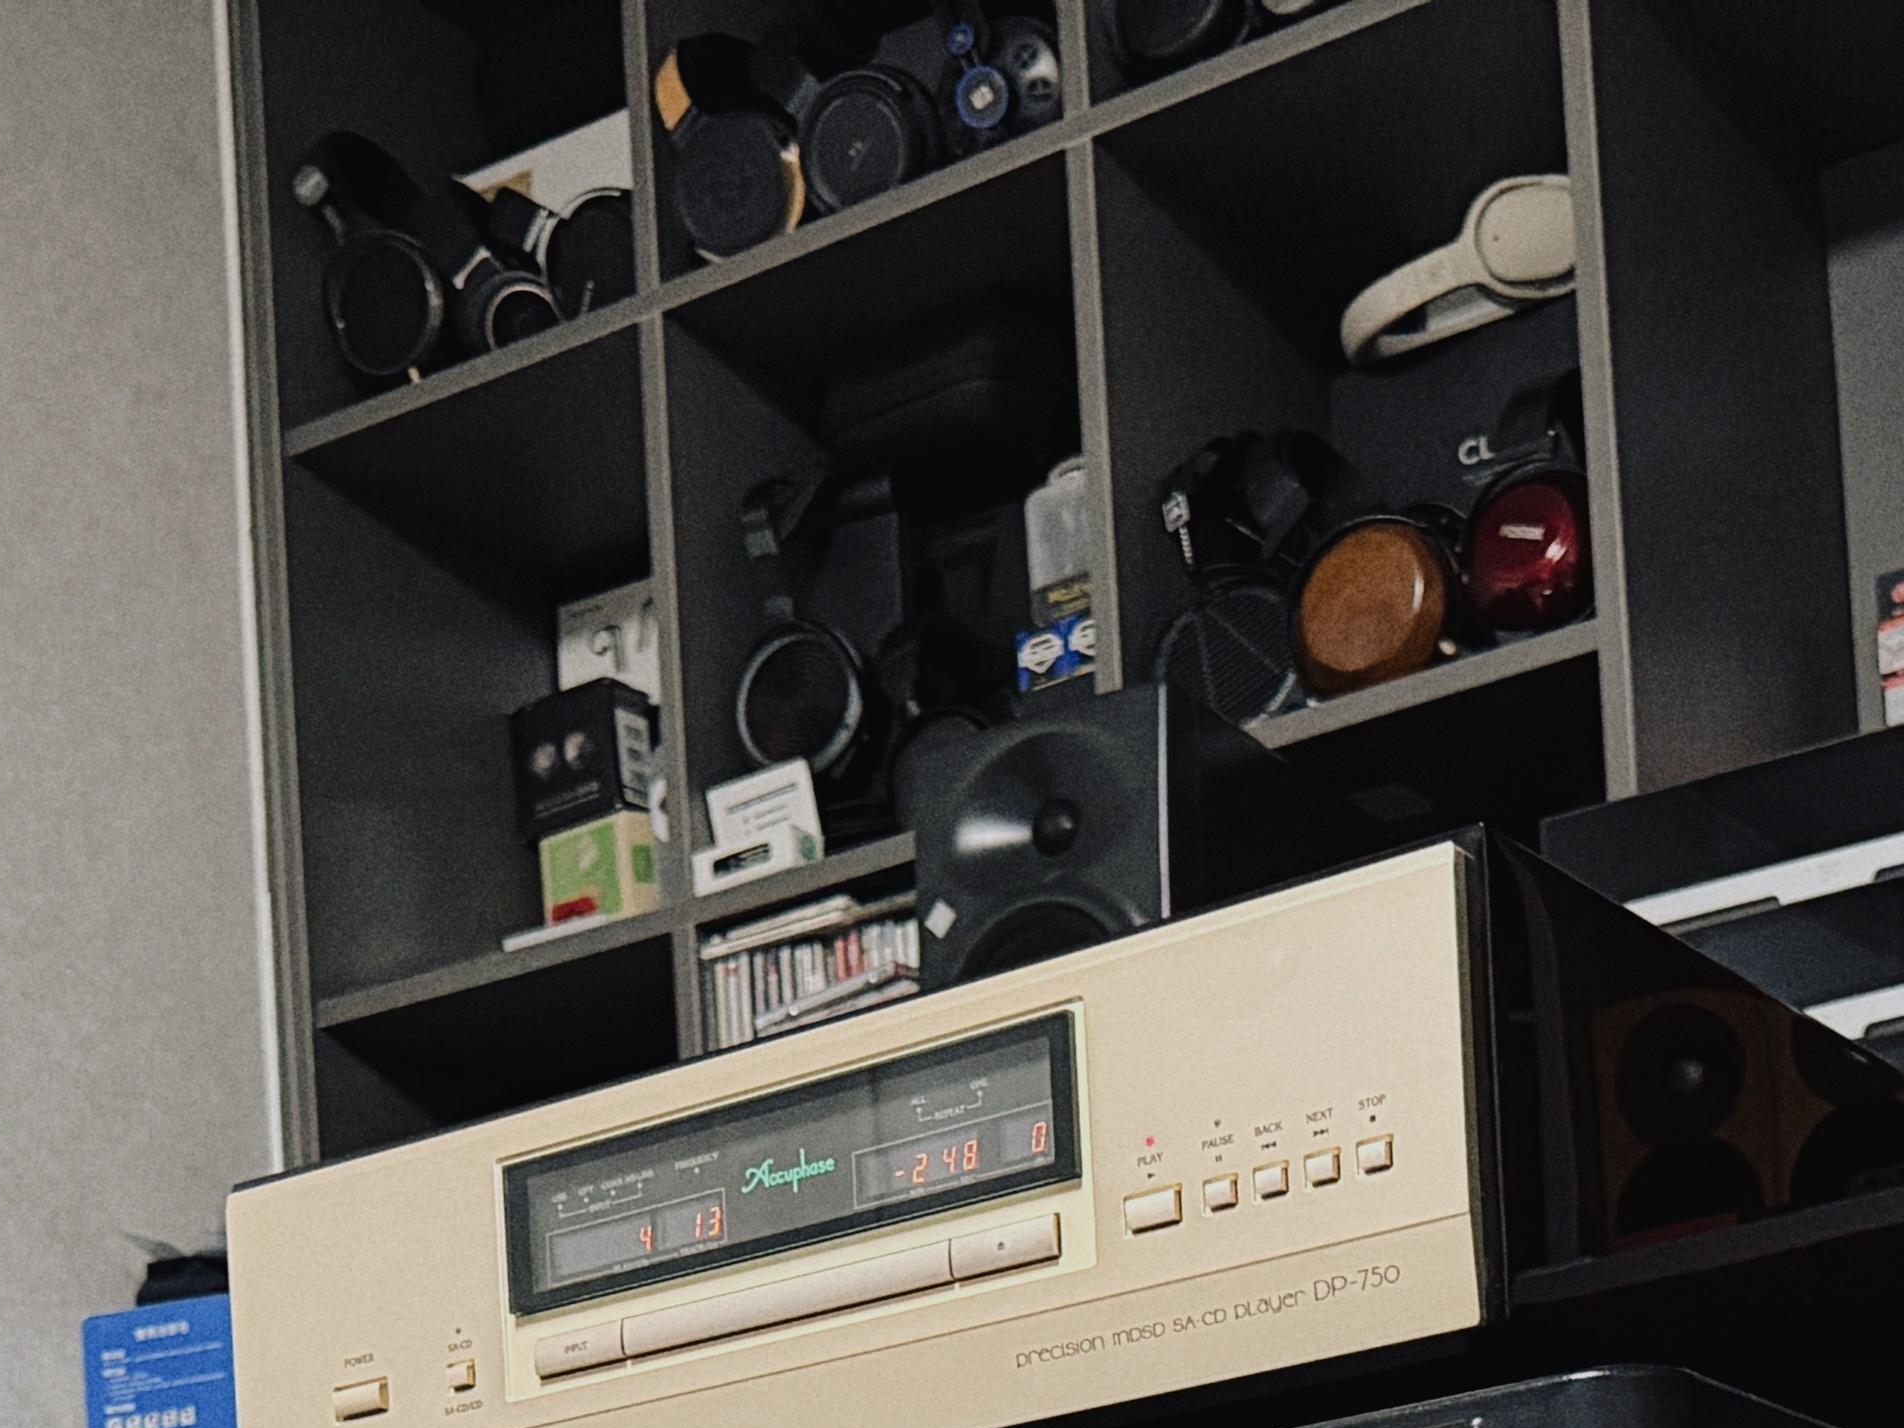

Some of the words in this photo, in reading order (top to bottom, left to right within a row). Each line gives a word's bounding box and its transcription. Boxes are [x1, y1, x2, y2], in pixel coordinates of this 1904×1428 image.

[1357, 1094, 1388, 1111] STOP
[1305, 1107, 1335, 1124] NEXT
[1254, 1120, 1284, 1138] BACK
[1200, 1133, 1235, 1152] PAUSE
[1136, 1151, 1165, 1168] PLAY
[741, 1147, 836, 1193] Accuphase
[639, 1225, 653, 1253] 4
[695, 1205, 721, 1238] 13
[1015, 1337, 1106, 1369] precision
[1172, 1307, 1228, 1333] SA-CD
[1313, 1263, 1401, 1302] DP-750
[563, 1340, 589, 1355] INPUT
[344, 1352, 375, 1368] POWER
